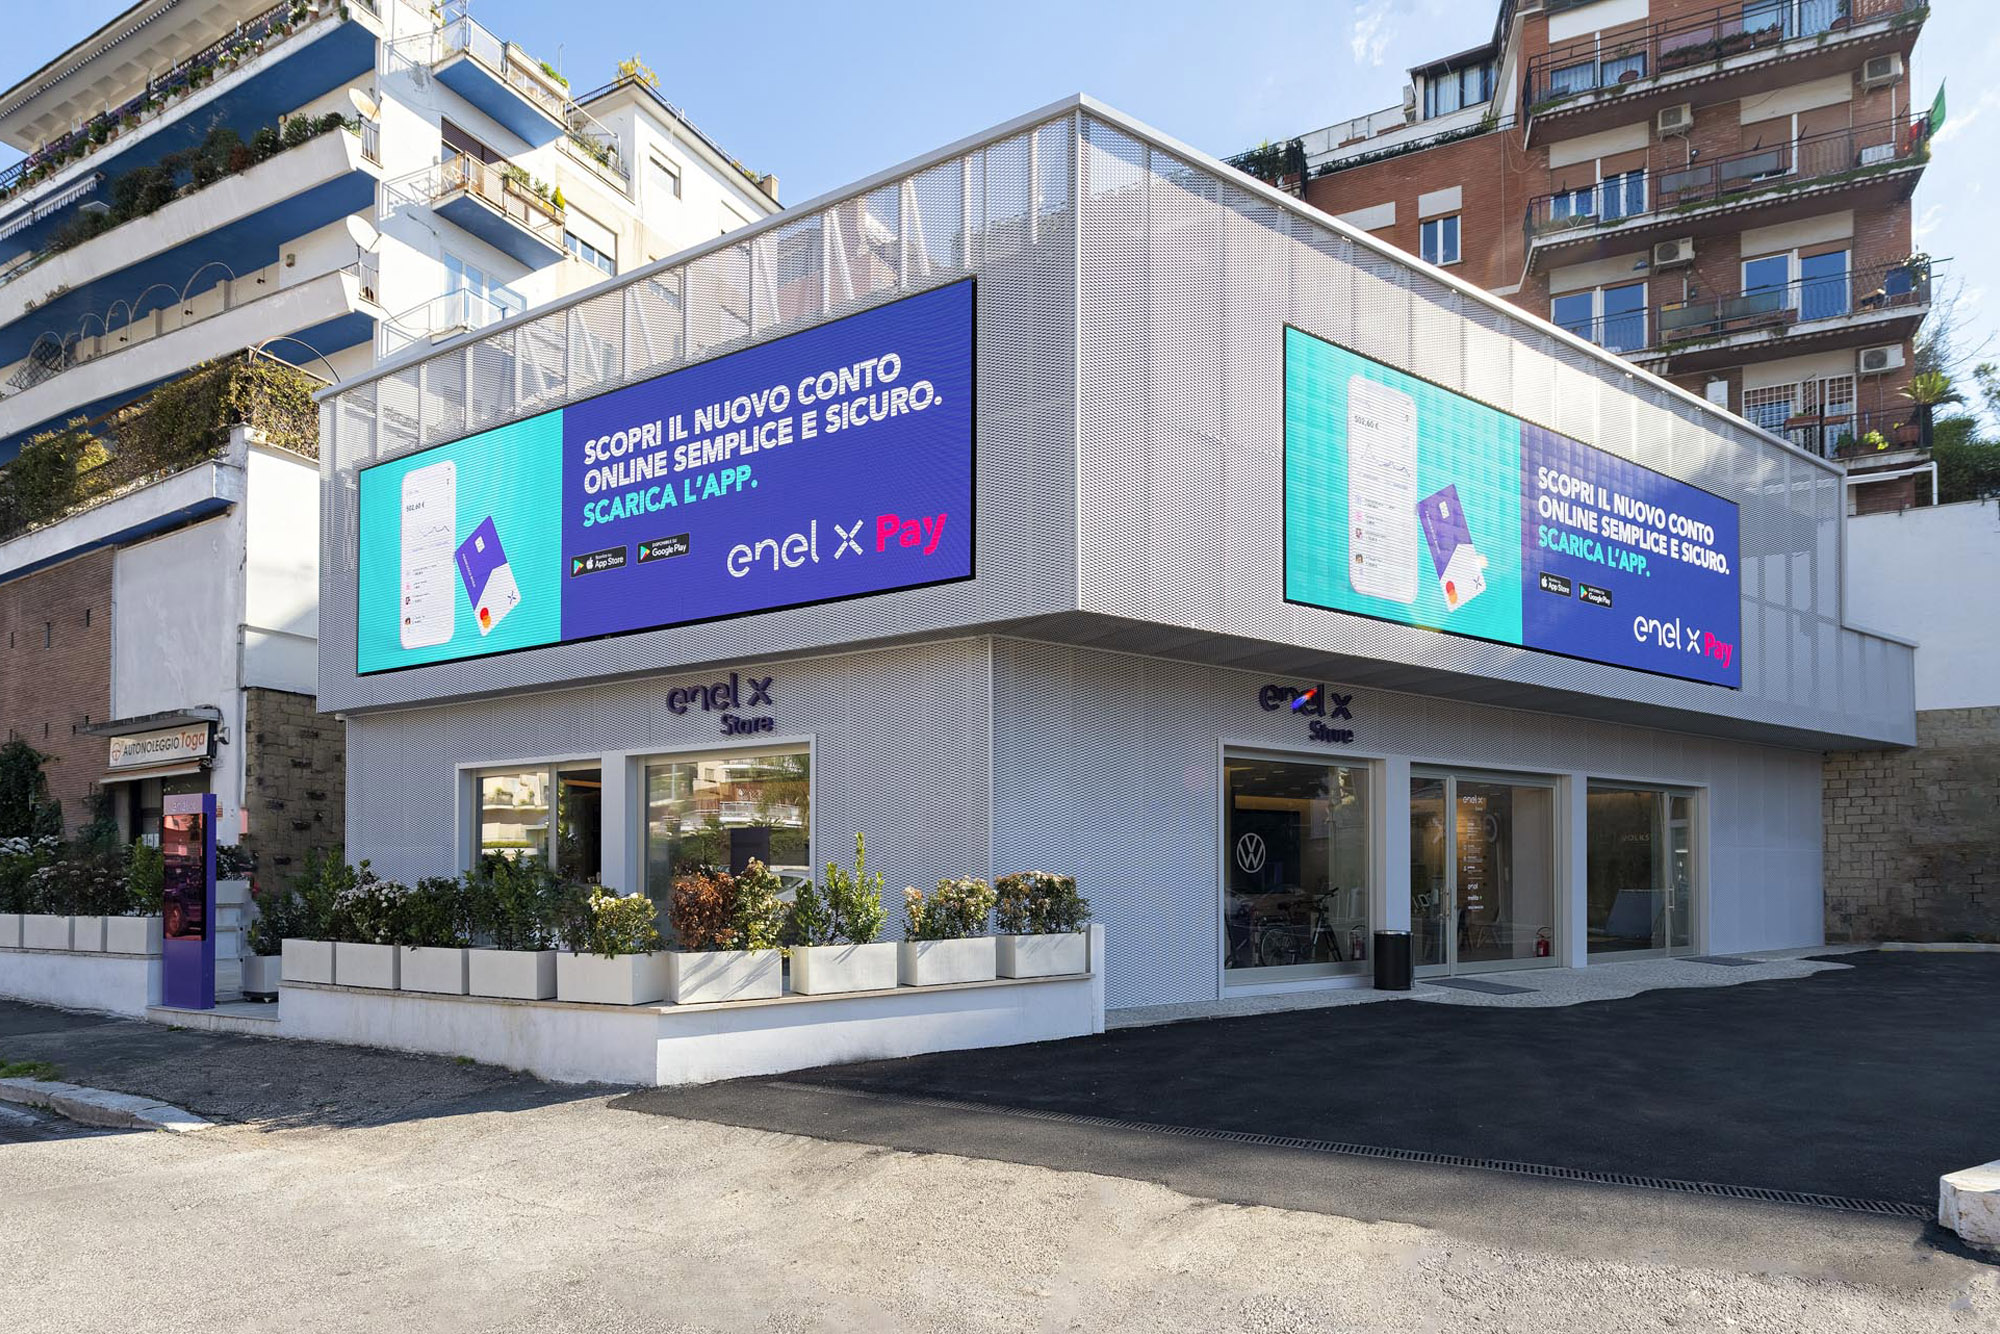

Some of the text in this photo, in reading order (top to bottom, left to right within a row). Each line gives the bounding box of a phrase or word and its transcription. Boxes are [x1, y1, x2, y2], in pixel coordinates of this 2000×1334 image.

[584, 352, 902, 465] SCOPRI IL NUOVO CONTO
[584, 380, 943, 494] ONLINE SEMPLICE E SICURO.
[583, 483, 678, 528] SCARICA
[1538, 466, 1715, 546] SCOPRI IL NUOVO CONTO
[651, 543, 687, 557] Google Play
[726, 519, 820, 578] enel
[876, 513, 948, 556] Pay
[1538, 495, 1731, 575] ONLINE SEMPLICE E SICURO.
[1538, 525, 1605, 565] SCARICA
[594, 556, 624, 569] App Store
[1548, 582, 1570, 593] App Store
[1588, 592, 1611, 606] Google Play
[1633, 615, 1682, 650] enel
[1704, 631, 1733, 669] Pay
[666, 672, 774, 715] enel x
[1259, 683, 1353, 720] enel x
[122, 731, 205, 756] AUTONOLEGGIO Toga
[720, 713, 775, 736] Store
